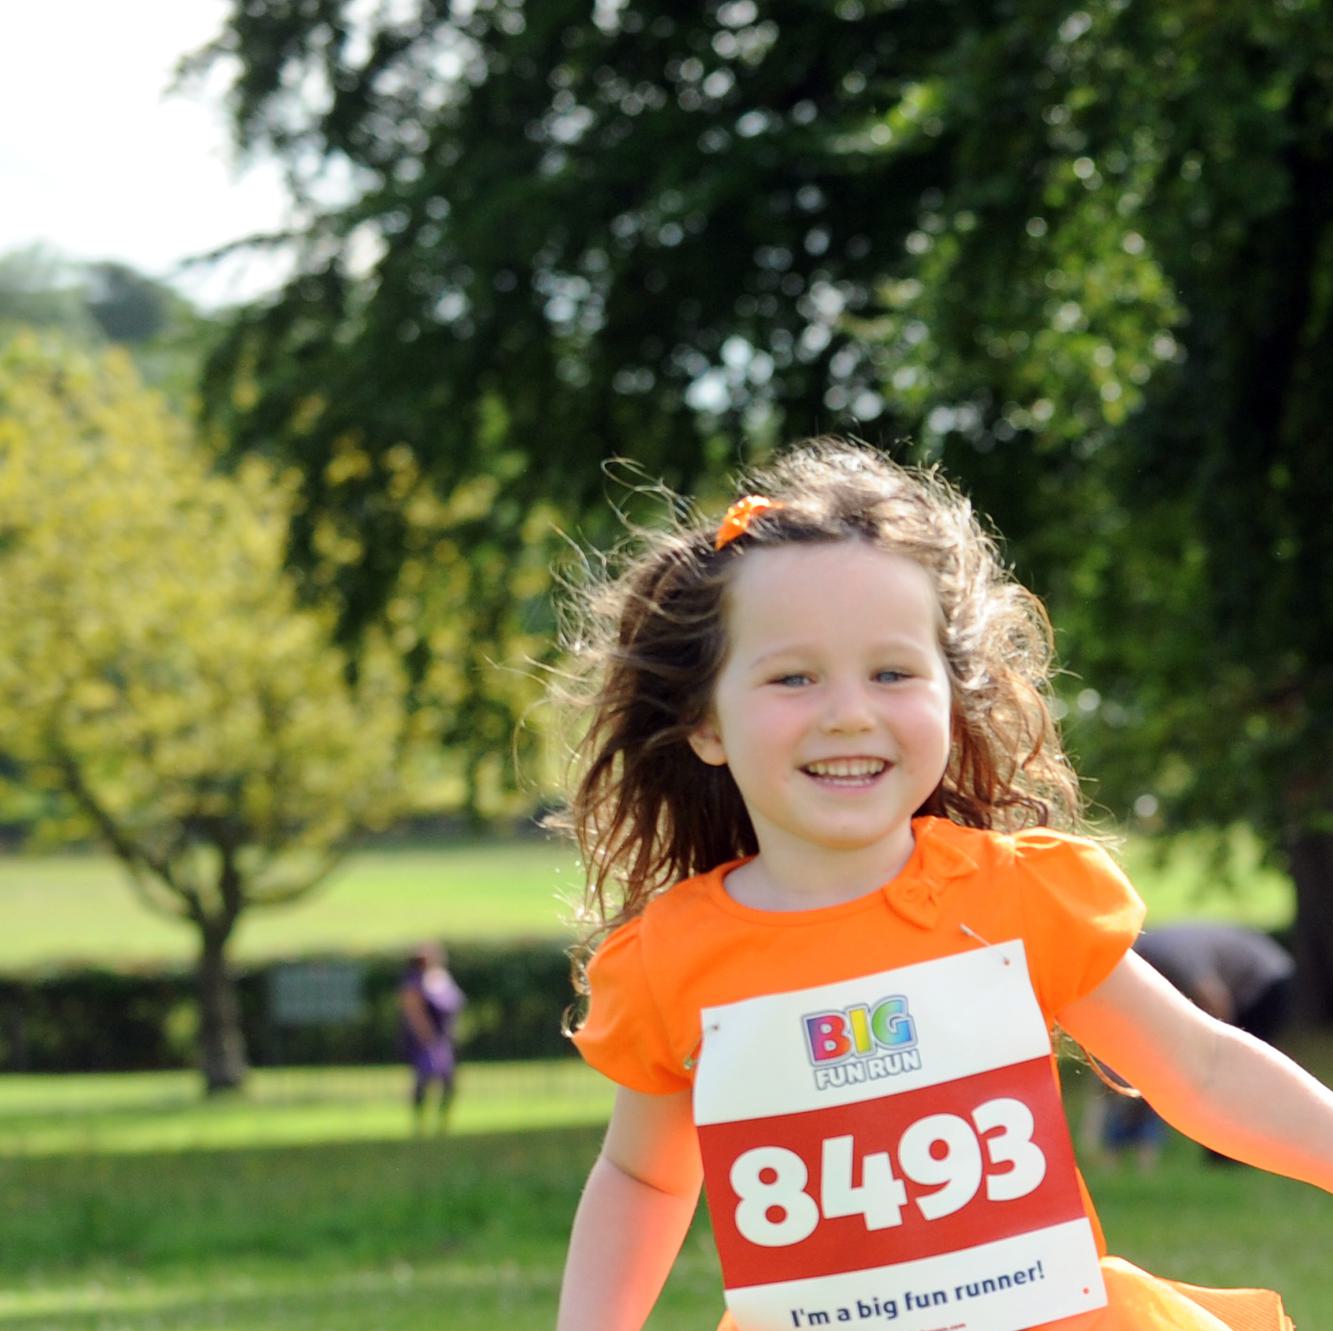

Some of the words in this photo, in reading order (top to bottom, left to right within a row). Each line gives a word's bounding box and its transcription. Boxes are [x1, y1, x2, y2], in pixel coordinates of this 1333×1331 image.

[800, 994, 918, 1067] BIG
[814, 1060, 867, 1091] FUN
[868, 1049, 922, 1081] RUN
[729, 1098, 1047, 1247] 8493
[791, 1306, 830, 1329] I'm
[837, 1305, 852, 1321] a
[857, 1296, 898, 1321] big
[904, 1288, 949, 1312] fun
[954, 1260, 1046, 1301] runner!
